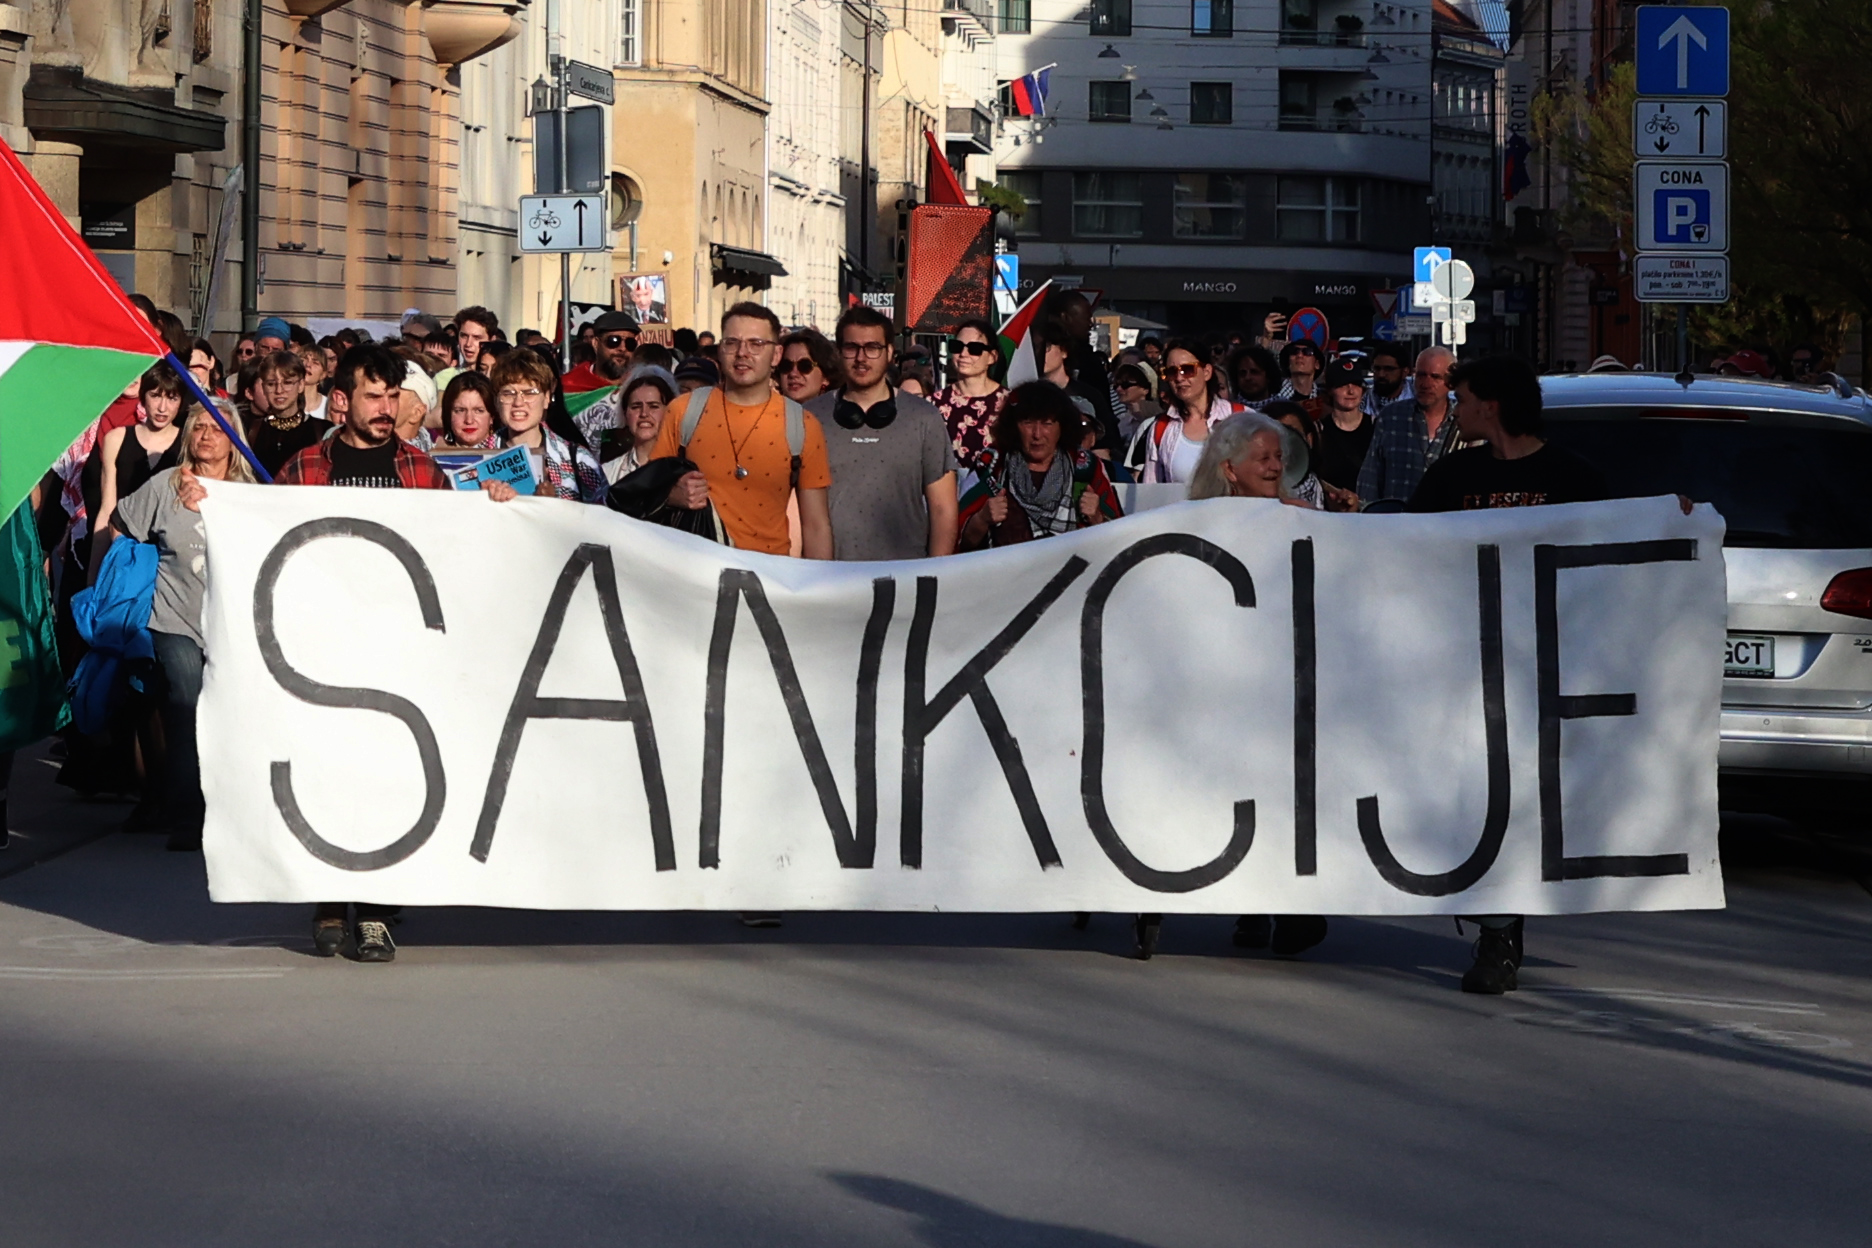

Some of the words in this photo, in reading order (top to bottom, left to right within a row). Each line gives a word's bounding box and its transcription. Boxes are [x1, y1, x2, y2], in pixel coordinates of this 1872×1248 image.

[1660, 170, 1703, 184] CONA
[1667, 196, 1696, 236] P
[1669, 259, 1691, 269] CONA
[1183, 281, 1236, 293] MANGO
[1315, 285, 1356, 295] MANGO
[486, 449, 524, 474] USrael
[510, 463, 526, 474] War
[253, 518, 1698, 894] SANKCIJE
